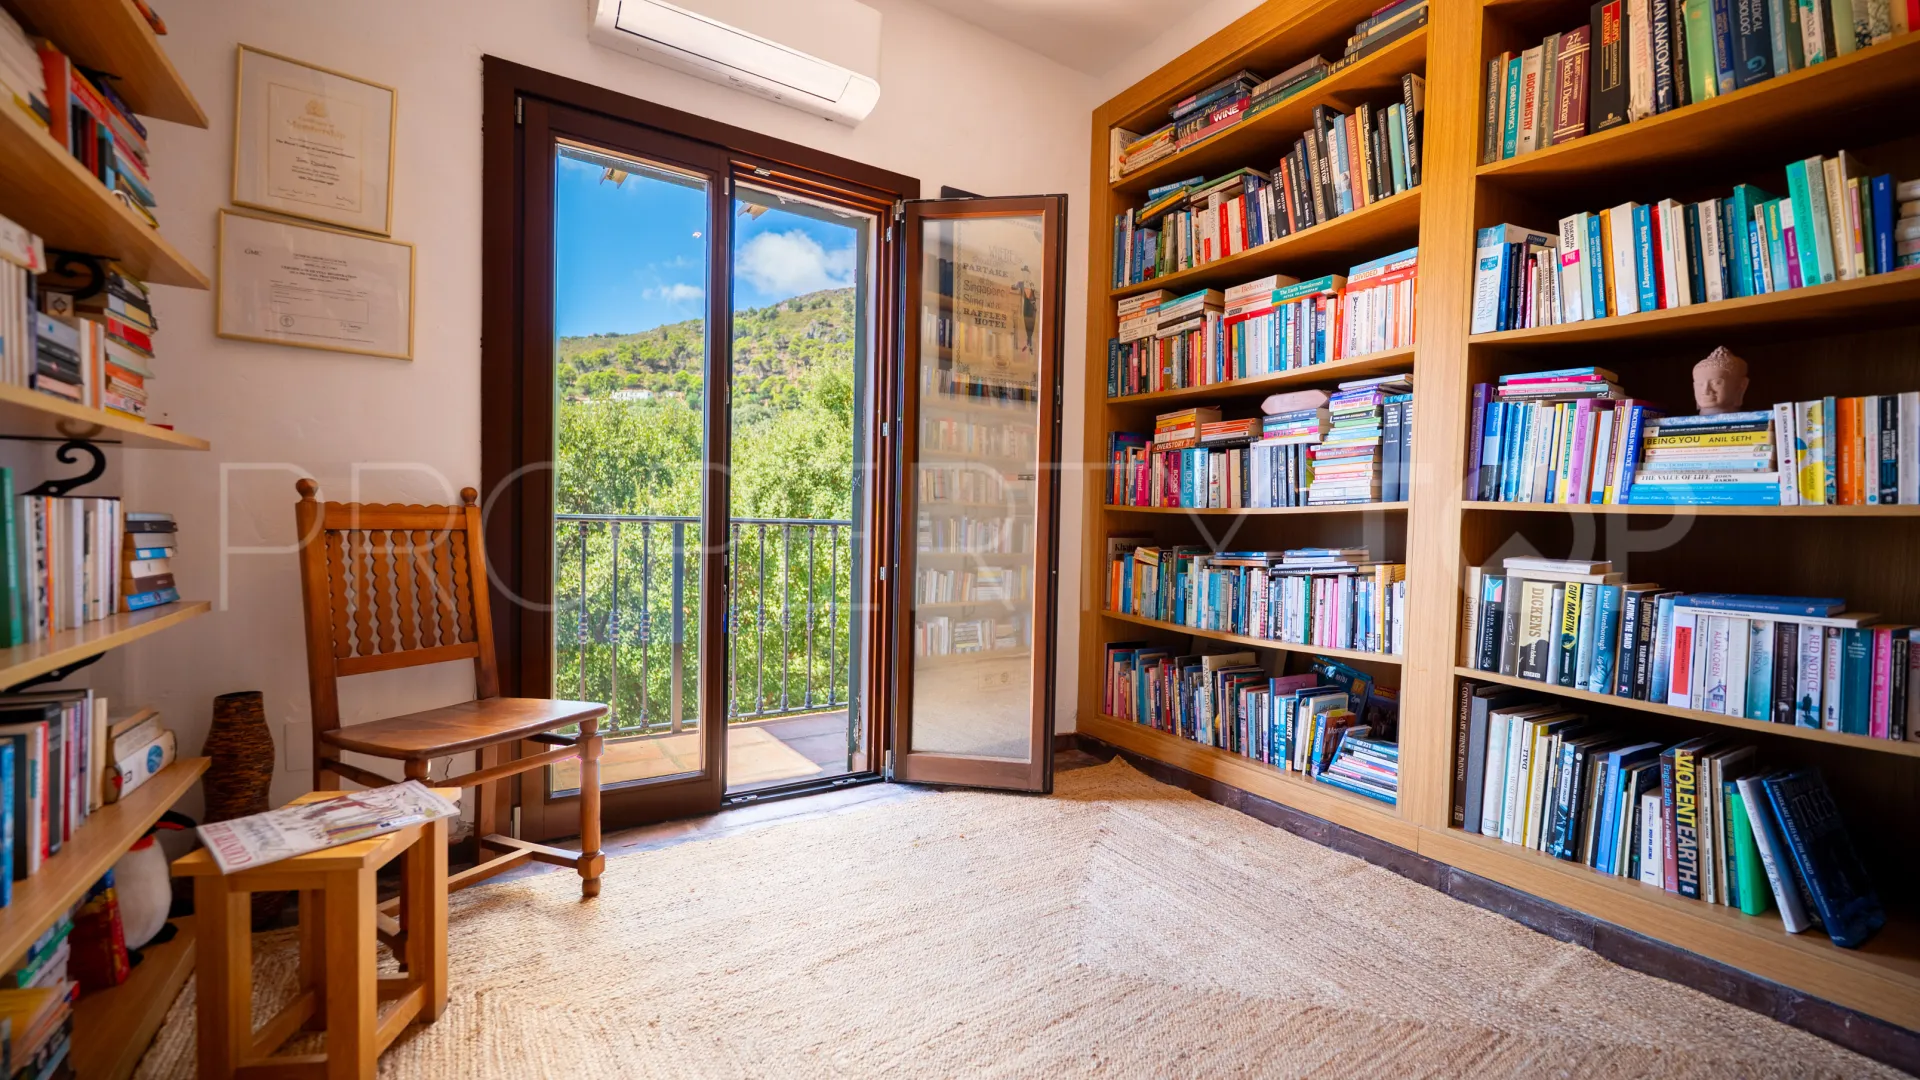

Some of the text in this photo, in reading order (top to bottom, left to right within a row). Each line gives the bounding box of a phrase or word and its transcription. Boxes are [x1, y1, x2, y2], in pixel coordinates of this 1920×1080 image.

[1655, 21, 1669, 76] ANATOMY
[1523, 71, 1536, 130] BIOCHEMISTRY
[1558, 56, 1572, 127] Medical Dictionary
[1213, 105, 1240, 122] WINE
[1404, 79, 1415, 140] NORMAN PARKINSON
[1313, 174, 1321, 196] MILLION
[1319, 158, 1327, 184] HISTORY
[962, 262, 1008, 277] PARTAKE
[1640, 225, 1650, 288] Basic Pharmacology
[962, 279, 1005, 297] Singapore
[1354, 269, 1378, 281] DIVIDED
[1476, 277, 1487, 320] MEDICINE
[1485, 274, 1495, 317] CLINICAL
[962, 307, 1007, 320] RAFFLES
[974, 316, 1006, 329] HOTEL
[1628, 408, 1638, 439] PROCEDURES
[1646, 437, 1676, 445] BEING
[1156, 440, 1185, 451] OVERSTORY
[1625, 444, 1633, 466] PRACTICE
[1463, 596, 1476, 631] Gandhi
[1527, 587, 1544, 638] DICKENS
[1564, 583, 1577, 633] GUY MARTIN
[1597, 590, 1610, 650] David Attenborough
[1623, 596, 1635, 649] PLAYING THE BAND
[1640, 602, 1651, 625] ANTONY
[1639, 626, 1649, 641] SHER
[1711, 630, 1722, 677] ALAN COREN
[1752, 639, 1762, 675] SIMPSON
[1807, 633, 1820, 692] RED NOTICE
[1828, 639, 1837, 680] DEAR LEADER
[1117, 676, 1127, 694] China
[1314, 724, 1322, 752] Morocco
[1456, 686, 1468, 781] CONTEMPORARY CHINESE PAINTING
[1661, 763, 1671, 786] Fragile
[1663, 786, 1672, 807] Earth
[1675, 752, 1698, 886] VIOLENT EARTH
[1771, 784, 1791, 819] REMARKABLE
[1798, 853, 1814, 875] WORLD
